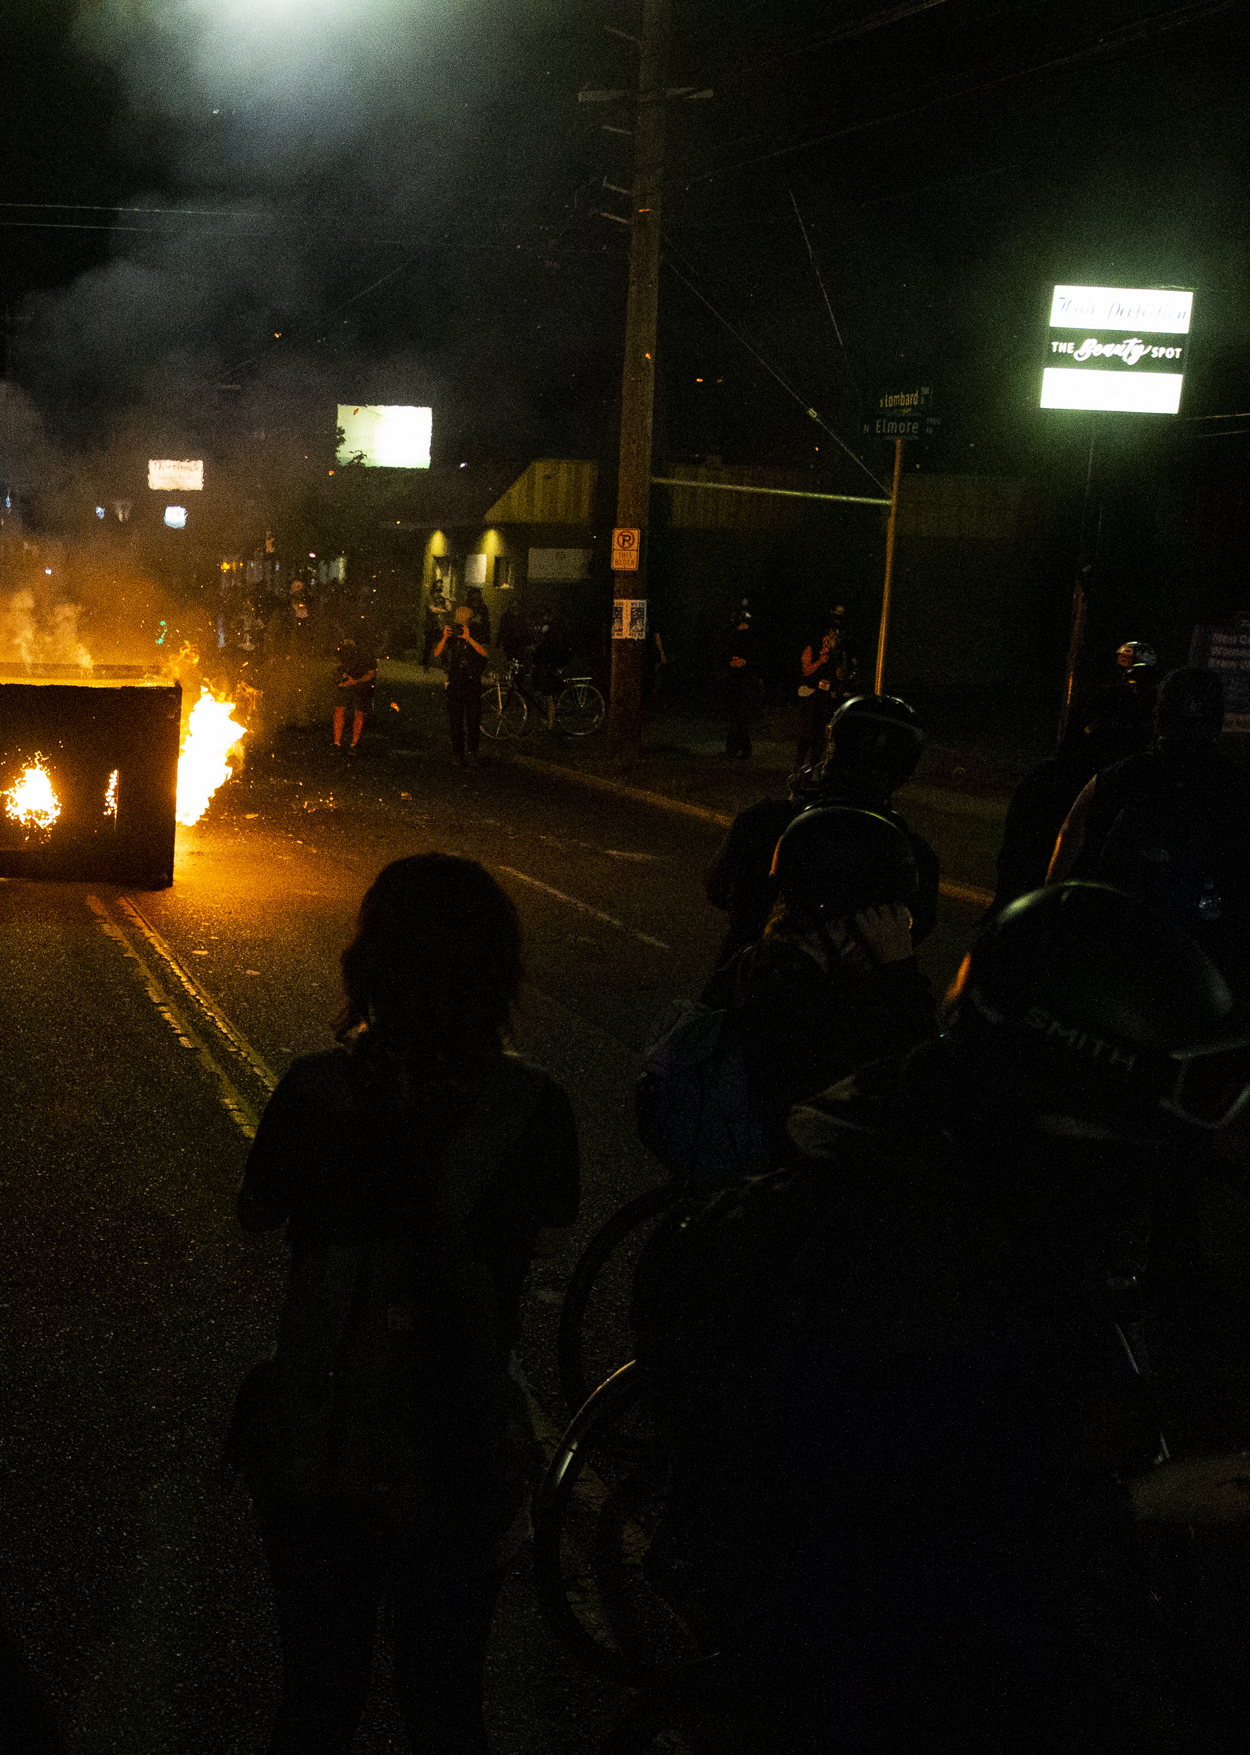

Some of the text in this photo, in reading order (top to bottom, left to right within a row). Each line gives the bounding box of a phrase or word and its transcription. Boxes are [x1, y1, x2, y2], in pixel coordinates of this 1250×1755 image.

[1052, 338, 1183, 365] THE Beauty SPOT
[885, 390, 919, 408] Lombard
[876, 418, 919, 434] Elmore
[1024, 1005, 1138, 1072] SMITH
